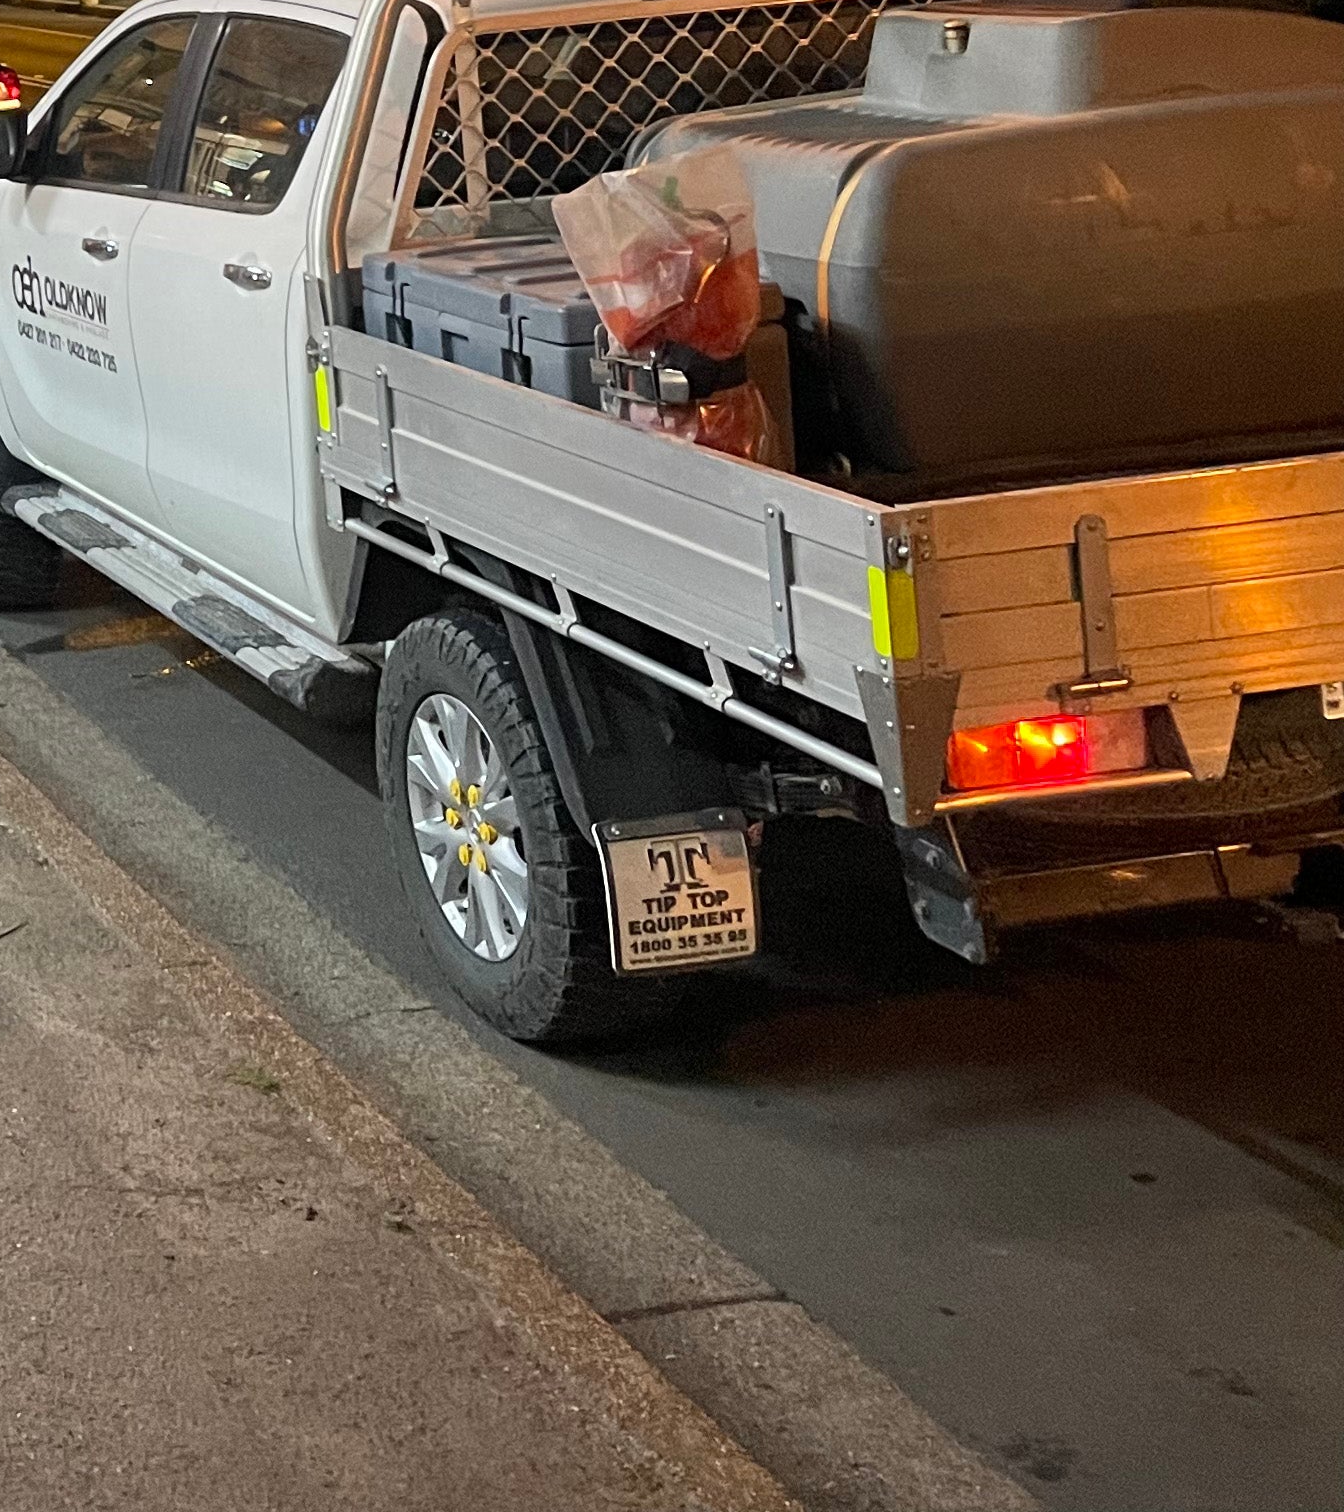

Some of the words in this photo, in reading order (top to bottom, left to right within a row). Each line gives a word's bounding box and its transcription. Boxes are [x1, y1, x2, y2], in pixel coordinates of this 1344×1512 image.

[44, 276, 108, 325] OLDKNOW
[642, 895, 678, 915] TIP
[687, 889, 730, 910] TOP
[628, 908, 746, 936] EQUIPMENT
[629, 938, 672, 955] 1800
[677, 935, 698, 949] 35
[703, 932, 724, 946] 35
